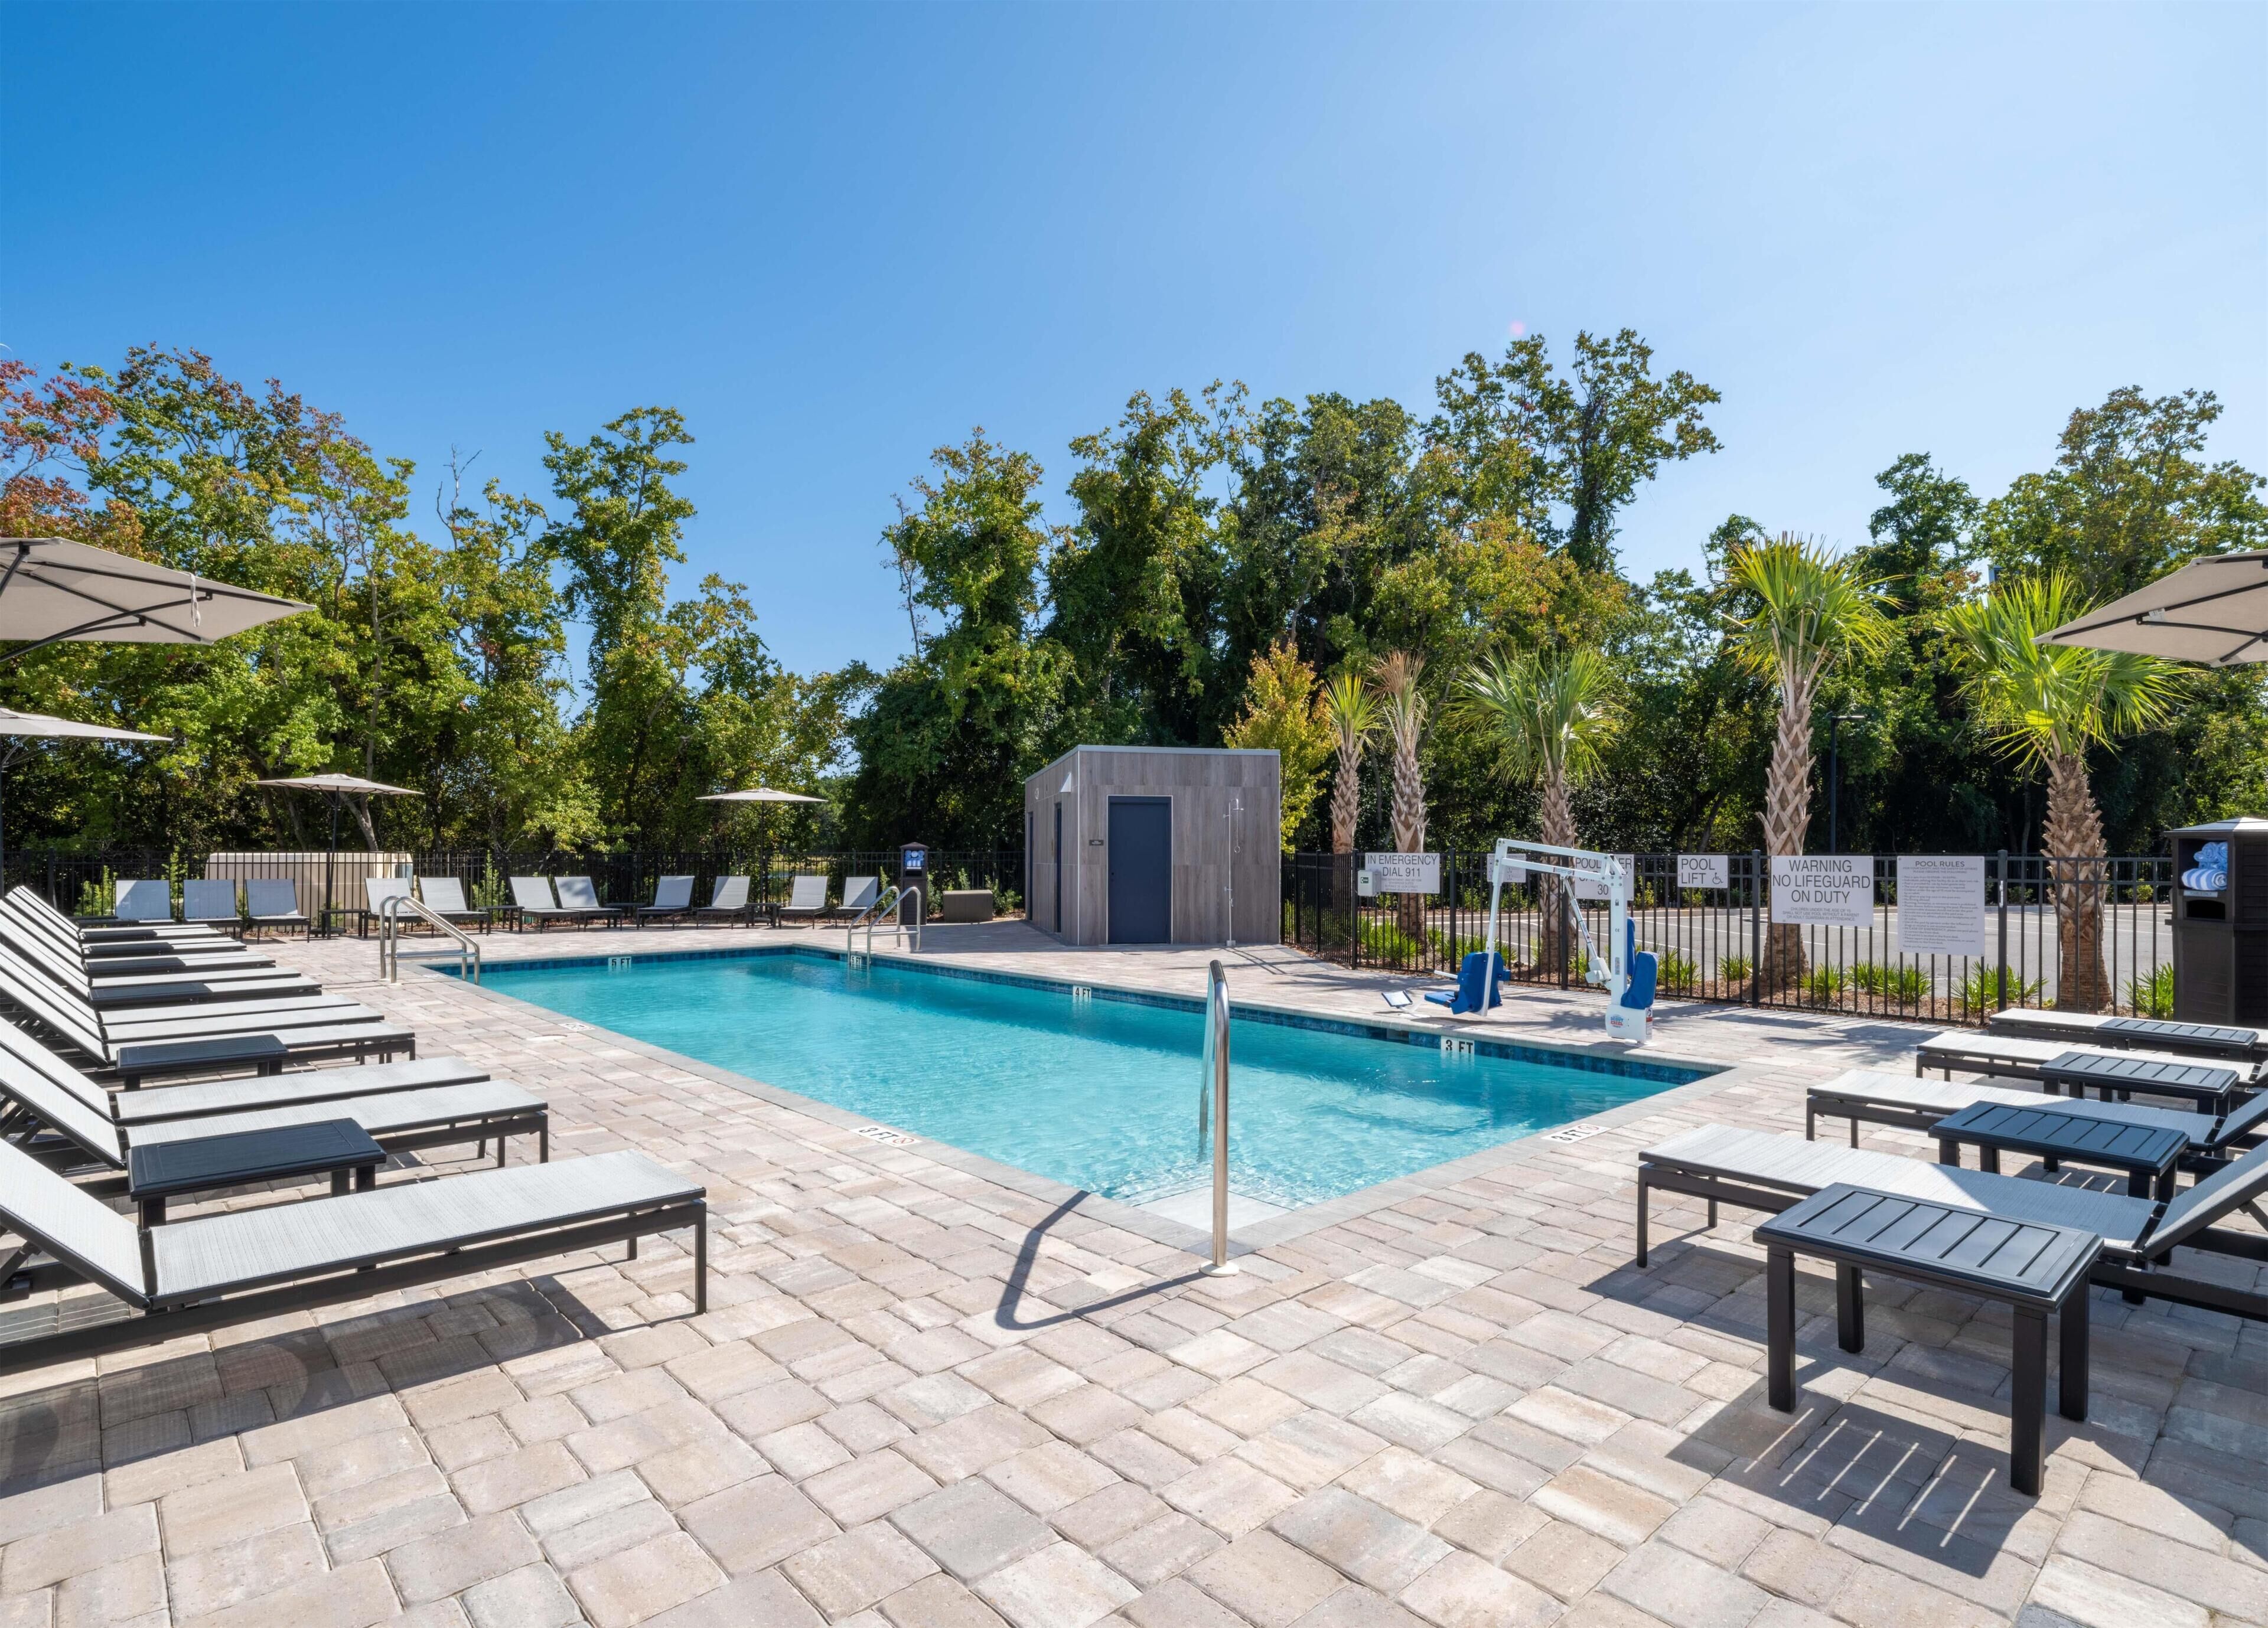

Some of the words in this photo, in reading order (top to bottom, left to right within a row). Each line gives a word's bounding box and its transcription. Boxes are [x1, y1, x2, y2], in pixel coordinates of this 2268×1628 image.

[1367, 854, 1376, 864] IN
[1379, 855, 1438, 865] EMERGENCY
[1575, 857, 1602, 869] POOL
[1681, 858, 1716, 870] POOL
[1789, 859, 1852, 873] WARNING
[1382, 867, 1403, 877] DIAL
[1405, 867, 1420, 877] 911
[1681, 872, 1706, 884] LIFT
[1772, 874, 1791, 887] NO
[1795, 875, 1871, 888] LIFEGUARD
[1597, 884, 1609, 895] 30
[1791, 889, 1810, 902] ON
[1814, 890, 1850, 903] DUTY
[621, 958, 630, 967] FT
[1075, 987, 1080, 996] 4
[1083, 988, 1090, 997] FT
[1445, 1039, 1453, 1051] 3
[1459, 1040, 1473, 1054] FT
[870, 1131, 900, 1140] FT
[1562, 1129, 1592, 1137] FT
